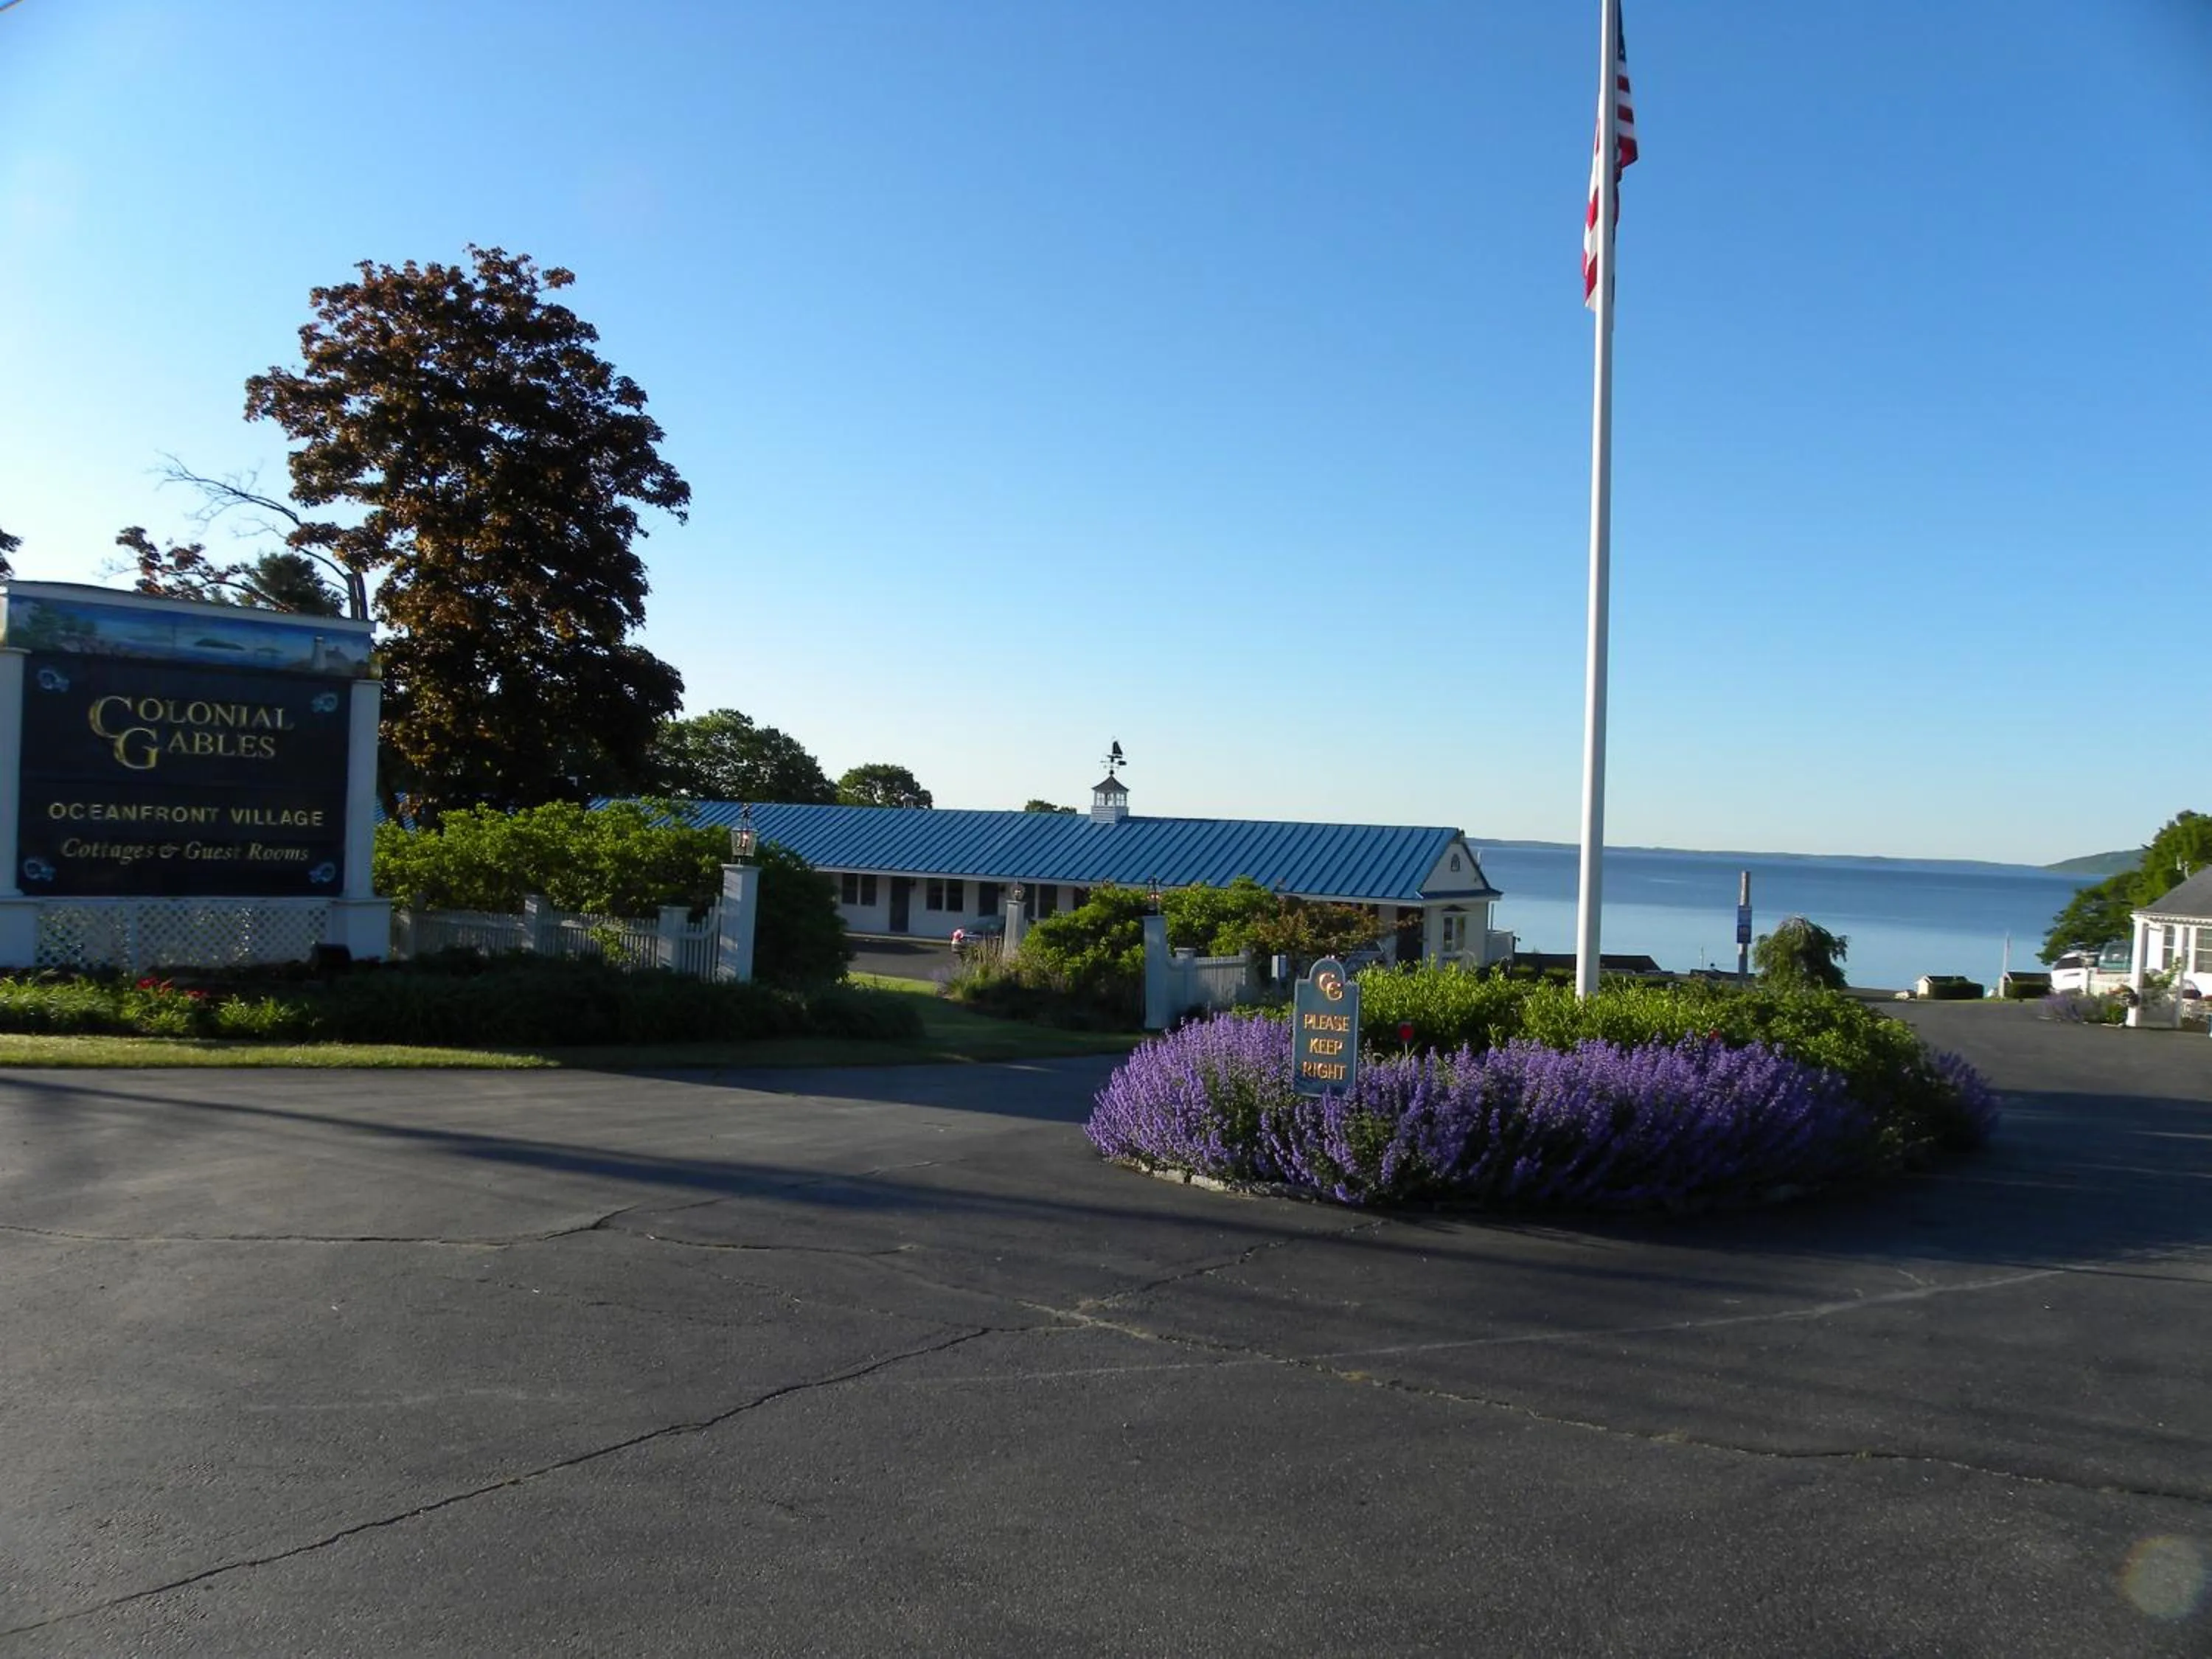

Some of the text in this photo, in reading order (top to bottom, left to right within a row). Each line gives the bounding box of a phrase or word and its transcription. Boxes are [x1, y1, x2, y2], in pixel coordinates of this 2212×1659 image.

[88, 695, 294, 738] COLONIAL
[114, 727, 276, 769] GABLES
[49, 802, 324, 827] OCEANFRONT VILLAGE
[61, 838, 310, 865] Cottages & Guest Rooms
[1304, 1014, 1350, 1032] PLEASE
[1309, 1037, 1343, 1056] KEEP
[1302, 1061, 1346, 1080] RIGHT
